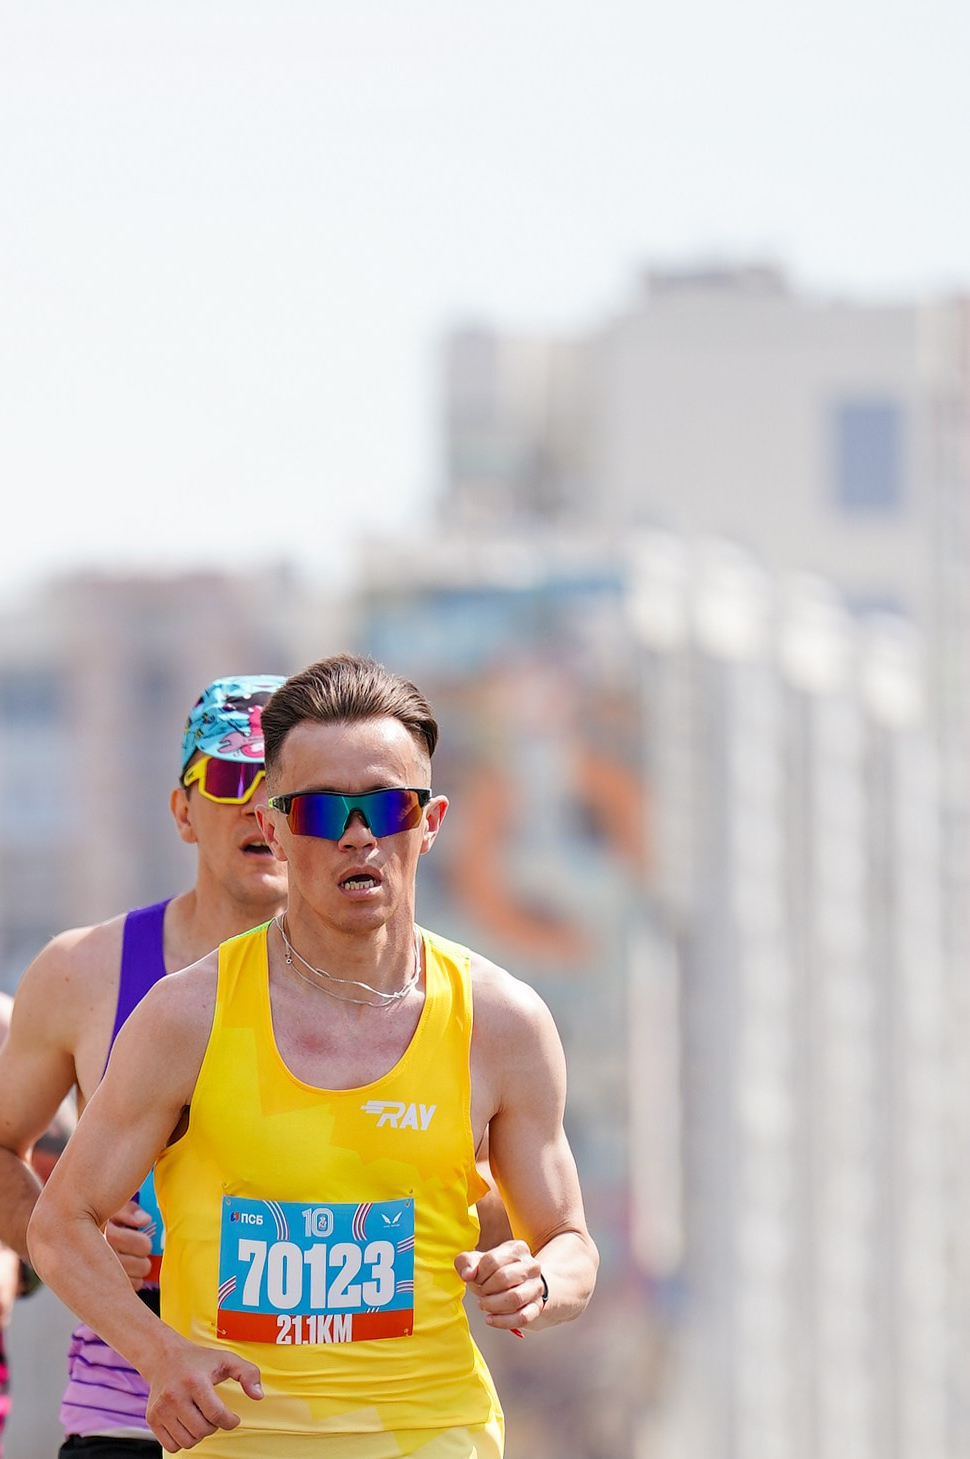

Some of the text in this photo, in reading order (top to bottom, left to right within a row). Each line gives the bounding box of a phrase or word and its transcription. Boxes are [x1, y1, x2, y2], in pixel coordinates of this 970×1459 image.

[360, 1099, 437, 1131] RAY
[241, 1212, 264, 1226] ПСБ
[301, 1207, 334, 1237] 10
[238, 1238, 396, 1310] 70123
[275, 1312, 353, 1345] 21.1KM
